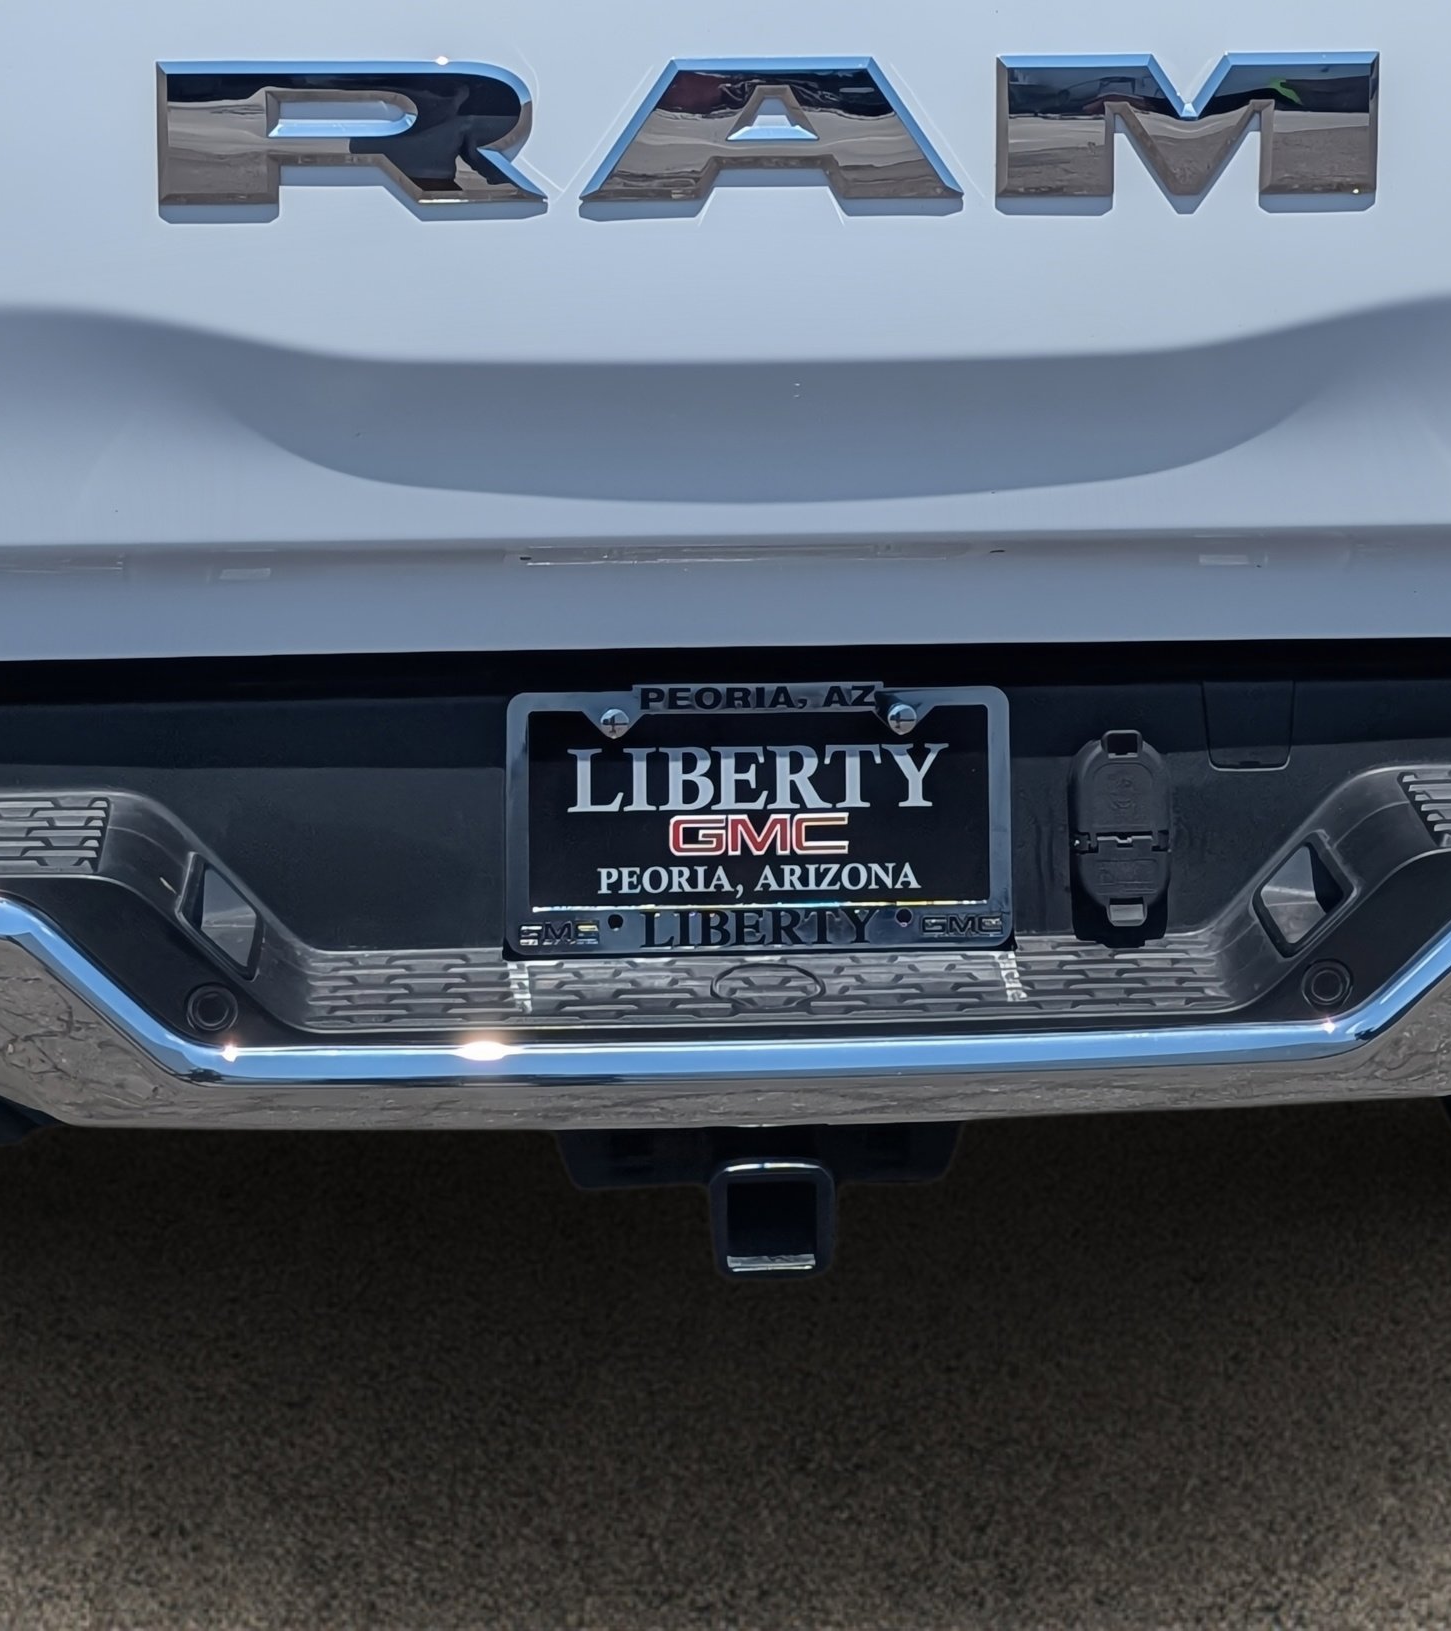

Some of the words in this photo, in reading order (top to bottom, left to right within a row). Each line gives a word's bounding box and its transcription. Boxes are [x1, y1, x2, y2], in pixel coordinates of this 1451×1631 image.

[155, 51, 1382, 204] RAM
[638, 686, 809, 712] PEORIA,
[825, 685, 877, 708] AZ
[567, 742, 949, 814] LIBERTY
[668, 812, 850, 857] GMC
[596, 865, 744, 898] PEORIA,
[753, 861, 922, 893] ARIZONA
[638, 908, 879, 949] LIBERTY
[920, 912, 1005, 937] GMC
